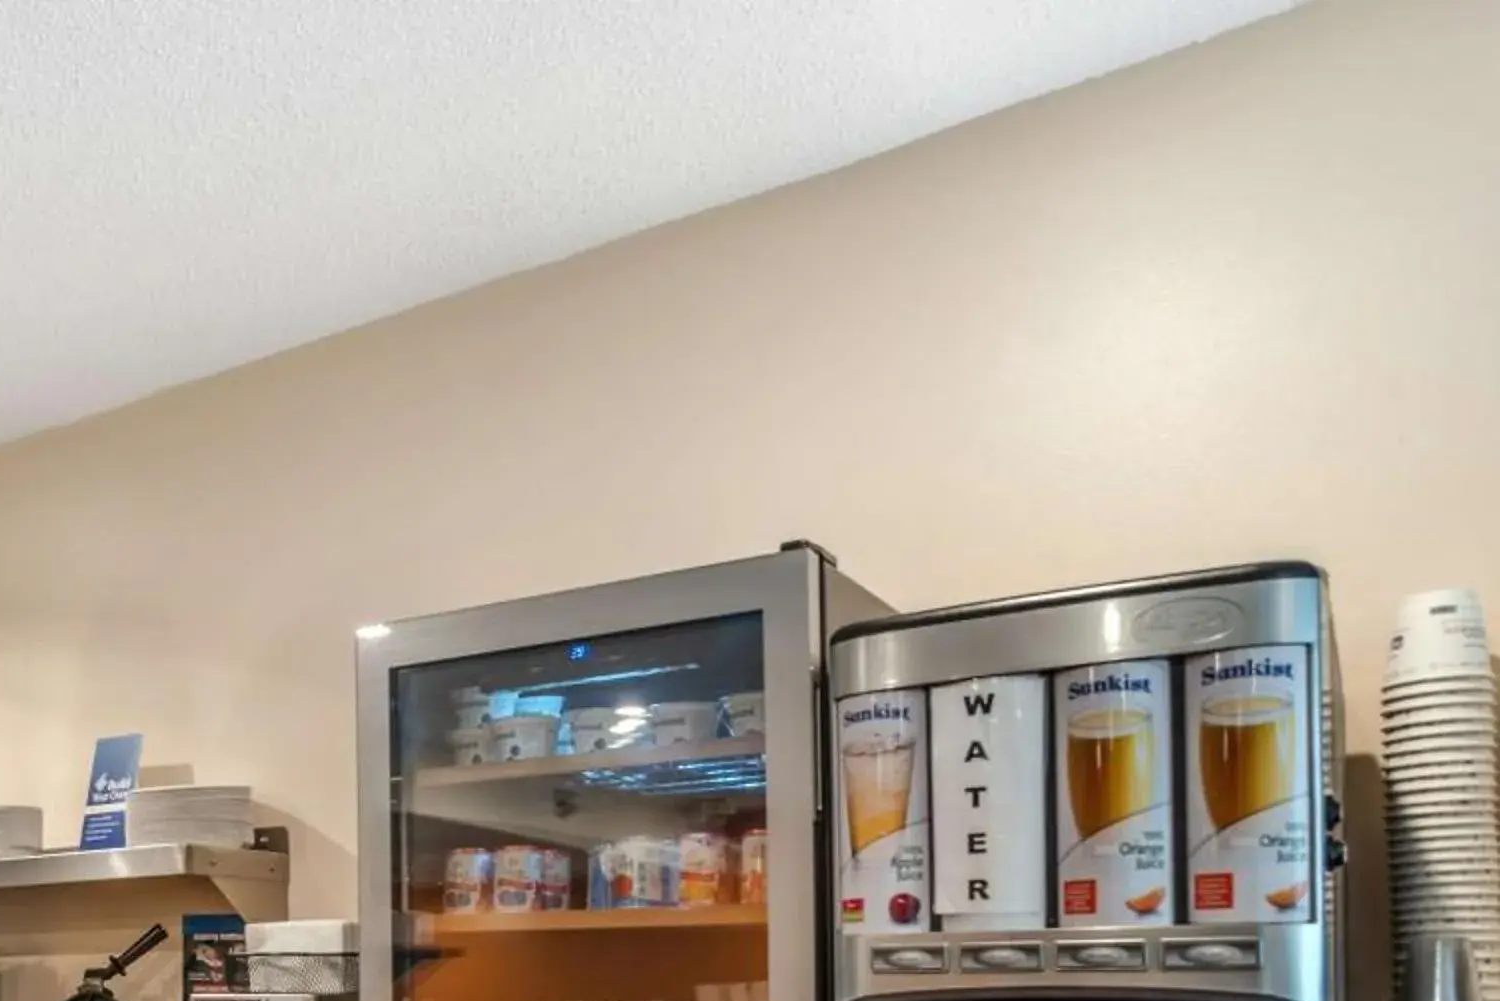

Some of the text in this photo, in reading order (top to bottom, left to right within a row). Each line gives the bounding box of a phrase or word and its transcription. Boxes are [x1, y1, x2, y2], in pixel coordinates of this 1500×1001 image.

[1200, 657, 1294, 686] Sunkist
[1067, 673, 1152, 700] Sunkist
[843, 702, 911, 728] Sunkist
[963, 693, 995, 901] WATER
